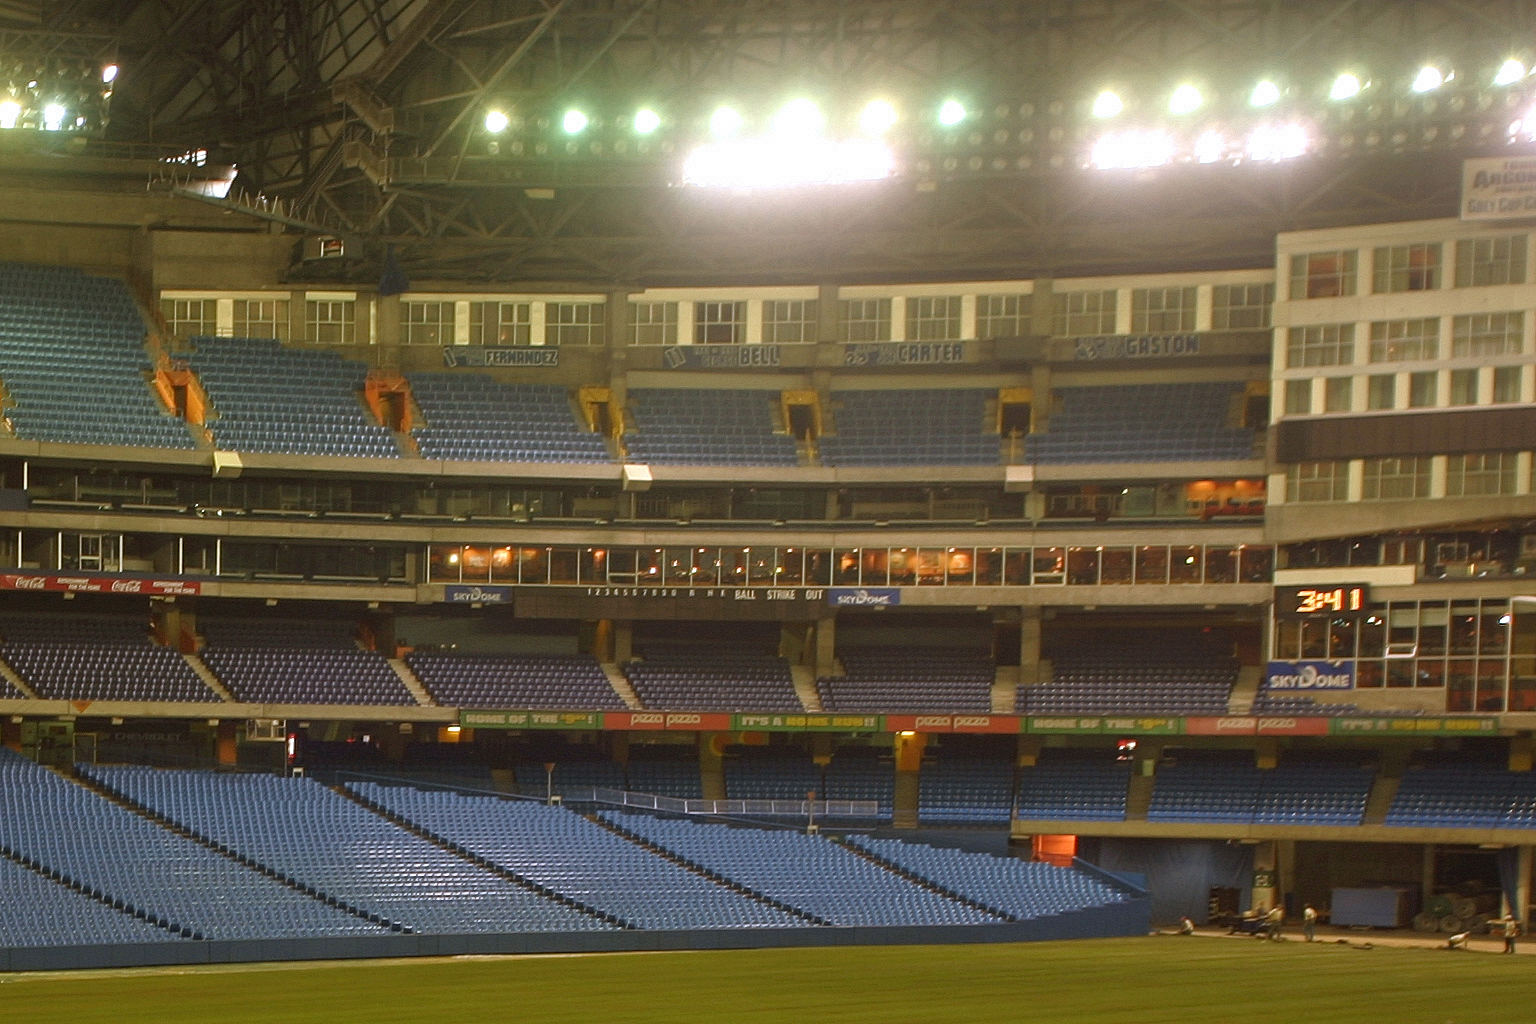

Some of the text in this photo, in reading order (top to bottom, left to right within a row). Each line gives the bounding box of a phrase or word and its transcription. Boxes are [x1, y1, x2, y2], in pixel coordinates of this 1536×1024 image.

[1125, 335, 1200, 357] GASTON
[485, 350, 558, 366] FERNANDEZ
[739, 346, 780, 366] BELL
[898, 344, 964, 364] CARTER
[735, 589, 756, 600] BALL
[766, 589, 795, 600] STRIKE
[805, 589, 823, 600] OUT
[1296, 588, 1363, 612] 3:41
[466, 714, 505, 724] HOME
[508, 714, 527, 724] OF
[532, 714, 559, 724] THE
[631, 714, 701, 727] pizza pizza
[772, 717, 782, 726] A
[915, 716, 989, 729] pizza pizza
[1033, 719, 1077, 728] HOME
[1080, 719, 1100, 728] OF
[1106, 719, 1135, 729] THE
[1217, 718, 1296, 731] pizza pizza
